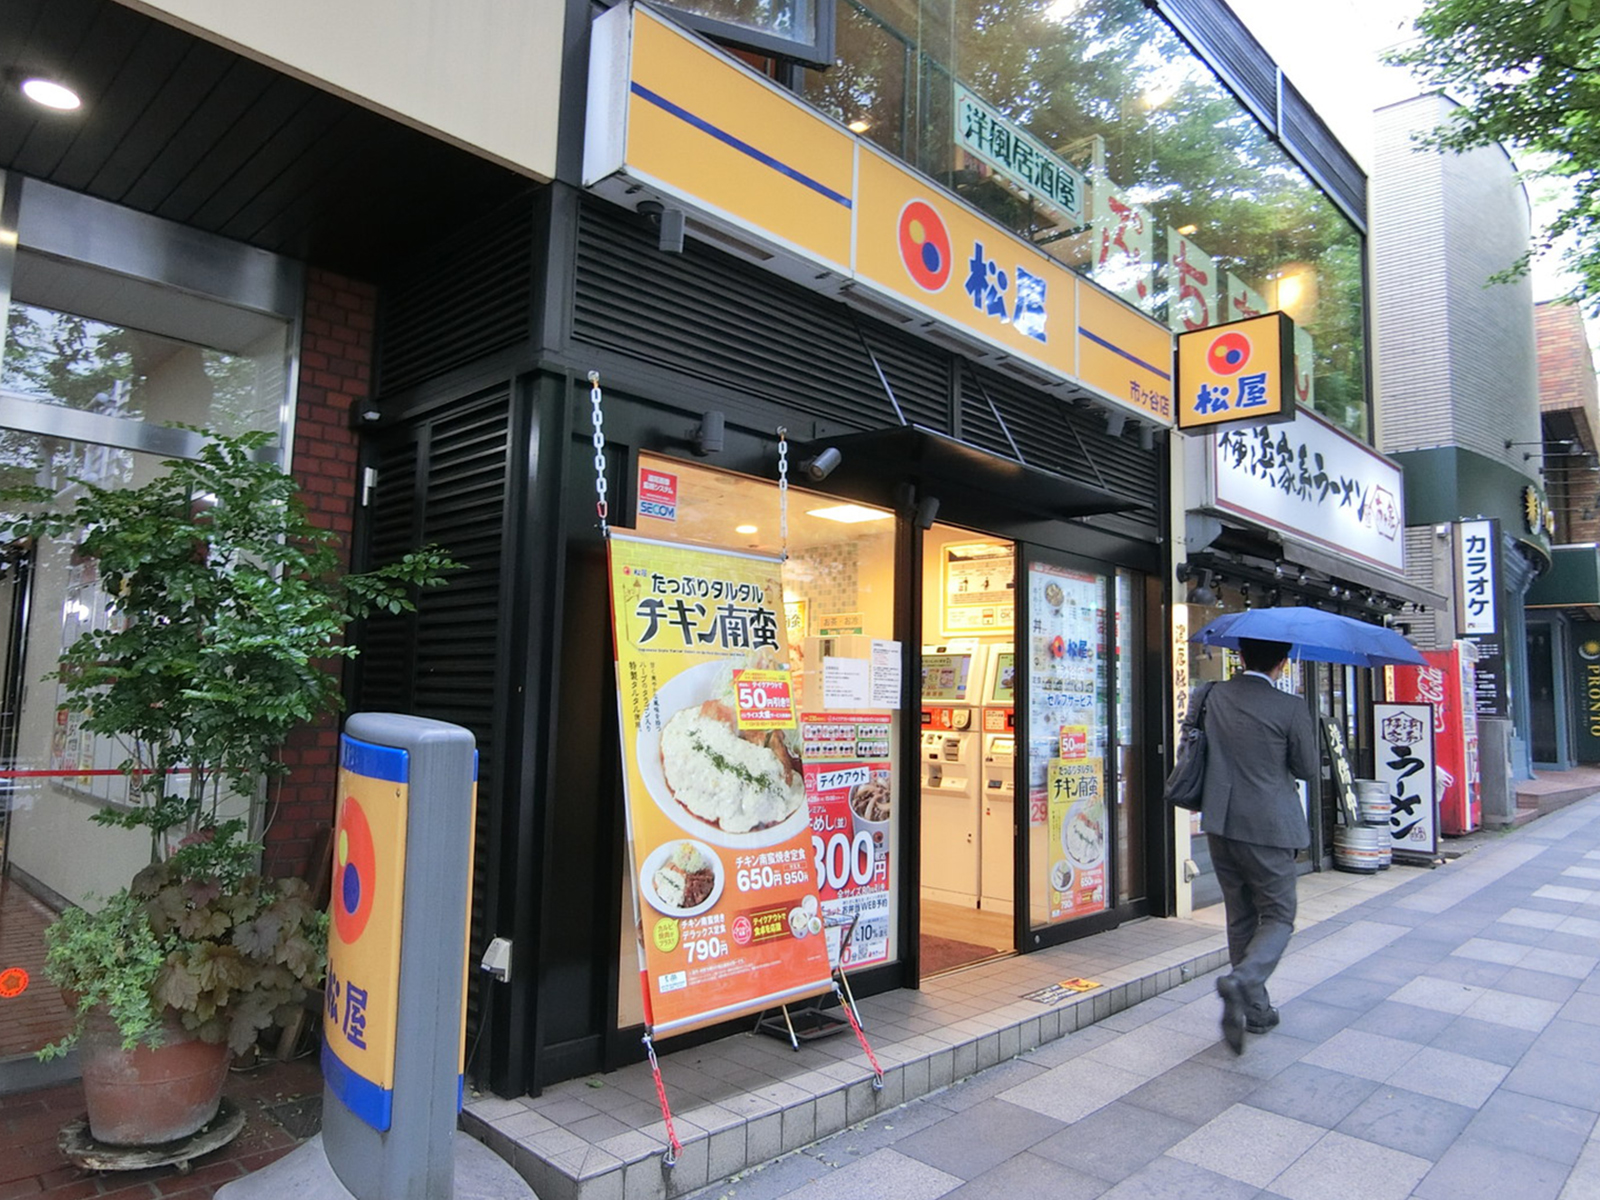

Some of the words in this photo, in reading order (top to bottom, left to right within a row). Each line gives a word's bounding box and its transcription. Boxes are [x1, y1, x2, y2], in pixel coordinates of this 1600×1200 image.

[965, 103, 1075, 212] 洋風居酒屋
[964, 239, 1047, 344] 松屋
[1129, 380, 1170, 417] 市ヶ谷店
[1193, 372, 1268, 415] 松屋
[640, 501, 675, 518] SECOM
[651, 573, 764, 604] たっぷりタルタル
[1465, 534, 1490, 616] カラオケ
[636, 598, 779, 651] チキン南蛮
[1067, 638, 1088, 659] 松屋
[1046, 694, 1094, 708] セルフサービス
[819, 769, 867, 788] テイクアウト
[1053, 777, 1099, 800] チキン南蛮
[1385, 745, 1426, 840] ラーメン
[736, 865, 783, 892] 650円
[783, 870, 809, 885] 950円
[683, 936, 729, 964] 790円
[326, 957, 369, 1051] 松屋
